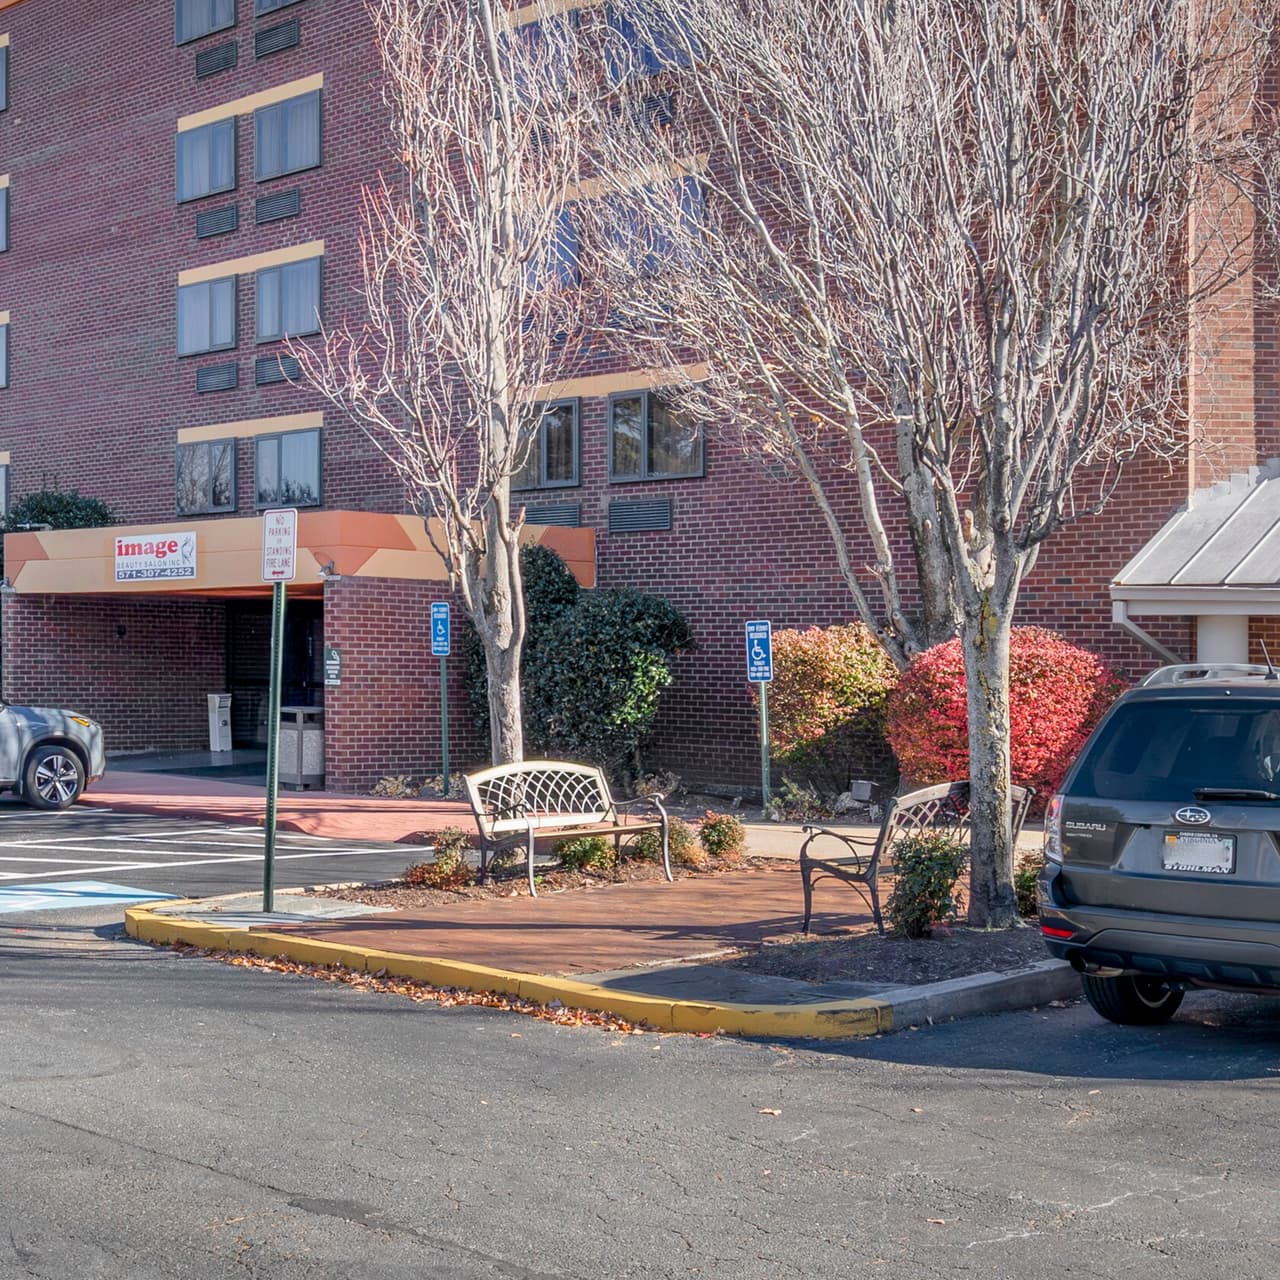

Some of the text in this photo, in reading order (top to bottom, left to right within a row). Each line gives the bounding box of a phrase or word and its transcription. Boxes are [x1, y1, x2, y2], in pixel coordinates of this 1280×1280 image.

[268, 526, 291, 537] PARKING
[116, 538, 179, 559] image
[116, 561, 143, 570] BEAUTY
[144, 559, 167, 569] SALON
[118, 567, 192, 579] 571-307-4252
[1065, 821, 1107, 831] SUBARU
[1164, 863, 1231, 874] STOHLMAN
